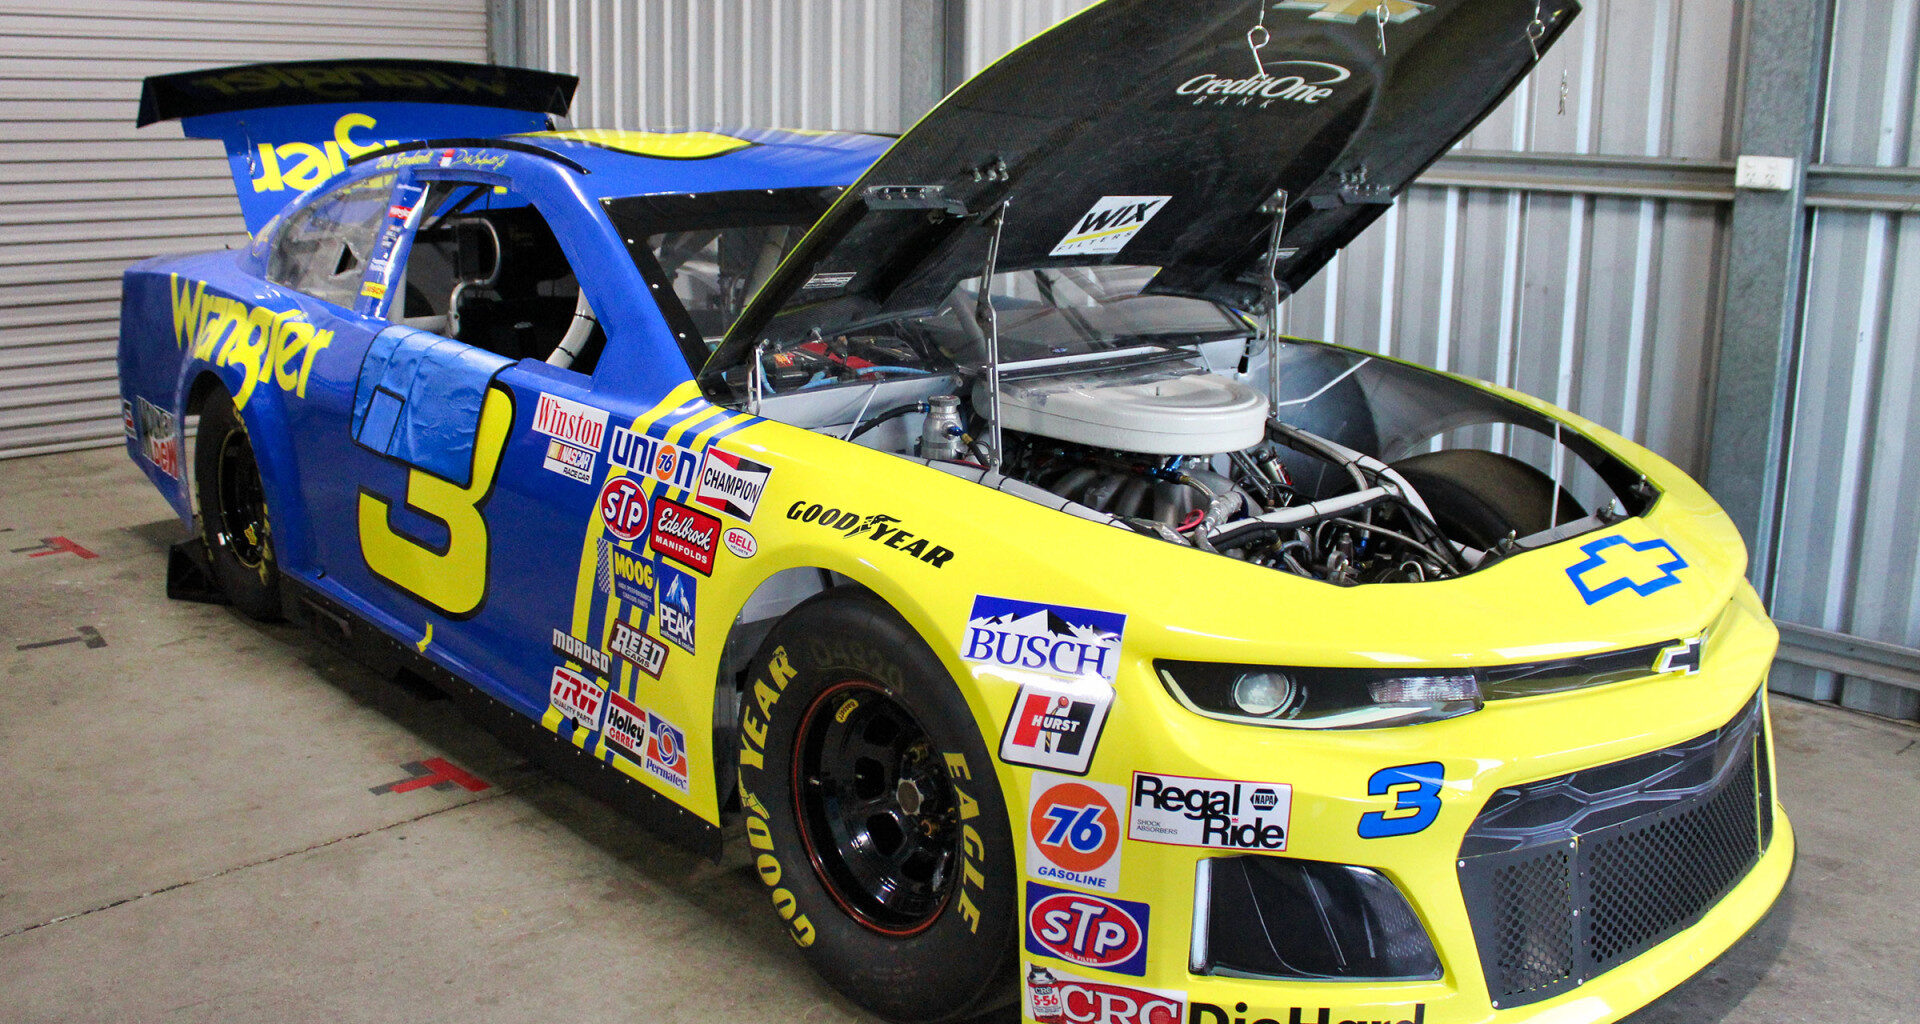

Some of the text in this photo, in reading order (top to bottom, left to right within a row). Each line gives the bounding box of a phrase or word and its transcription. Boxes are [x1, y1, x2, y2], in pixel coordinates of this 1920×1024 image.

[1193, 95, 1275, 109] BANK
[1077, 200, 1160, 234] WIX
[1057, 231, 1133, 252] FILTERS
[170, 272, 335, 411] Wrangler
[538, 396, 603, 449] Winston
[559, 446, 591, 471] NASCAR
[563, 467, 591, 482] RACE CAR
[657, 453, 673, 472] 76
[704, 468, 760, 503] CHAMPION
[604, 484, 643, 532] STP
[658, 507, 714, 551] Edelbrock
[728, 532, 753, 552] BELL
[655, 535, 707, 564] MANIFOLDS
[614, 552, 654, 590] MOOG
[660, 602, 695, 645] PEAK
[553, 628, 609, 674] MOROSO
[611, 623, 666, 675] REED
[625, 649, 650, 668] CAMS
[964, 627, 1111, 679] BUSCH
[553, 670, 602, 716] TRW
[554, 697, 593, 726] QUALITY PARTS
[608, 706, 644, 748] Holley
[1031, 714, 1080, 732] HURST
[609, 728, 635, 749] CARBS
[646, 758, 687, 790] Permatex
[1135, 775, 1241, 820] Regal
[1254, 794, 1275, 805] NAPA
[1357, 761, 1445, 839] 3
[1041, 803, 1107, 854] 76
[1137, 819, 1161, 827] SHOCK
[1137, 826, 1178, 835] ABSORBERS
[1202, 818, 1284, 849] Ride
[942, 752, 985, 934] EAGLE
[1038, 866, 1107, 888] GASOLINE
[1040, 901, 1126, 956] STP
[1065, 951, 1098, 963] OIL FILTER
[1060, 984, 1178, 1024] CRC
